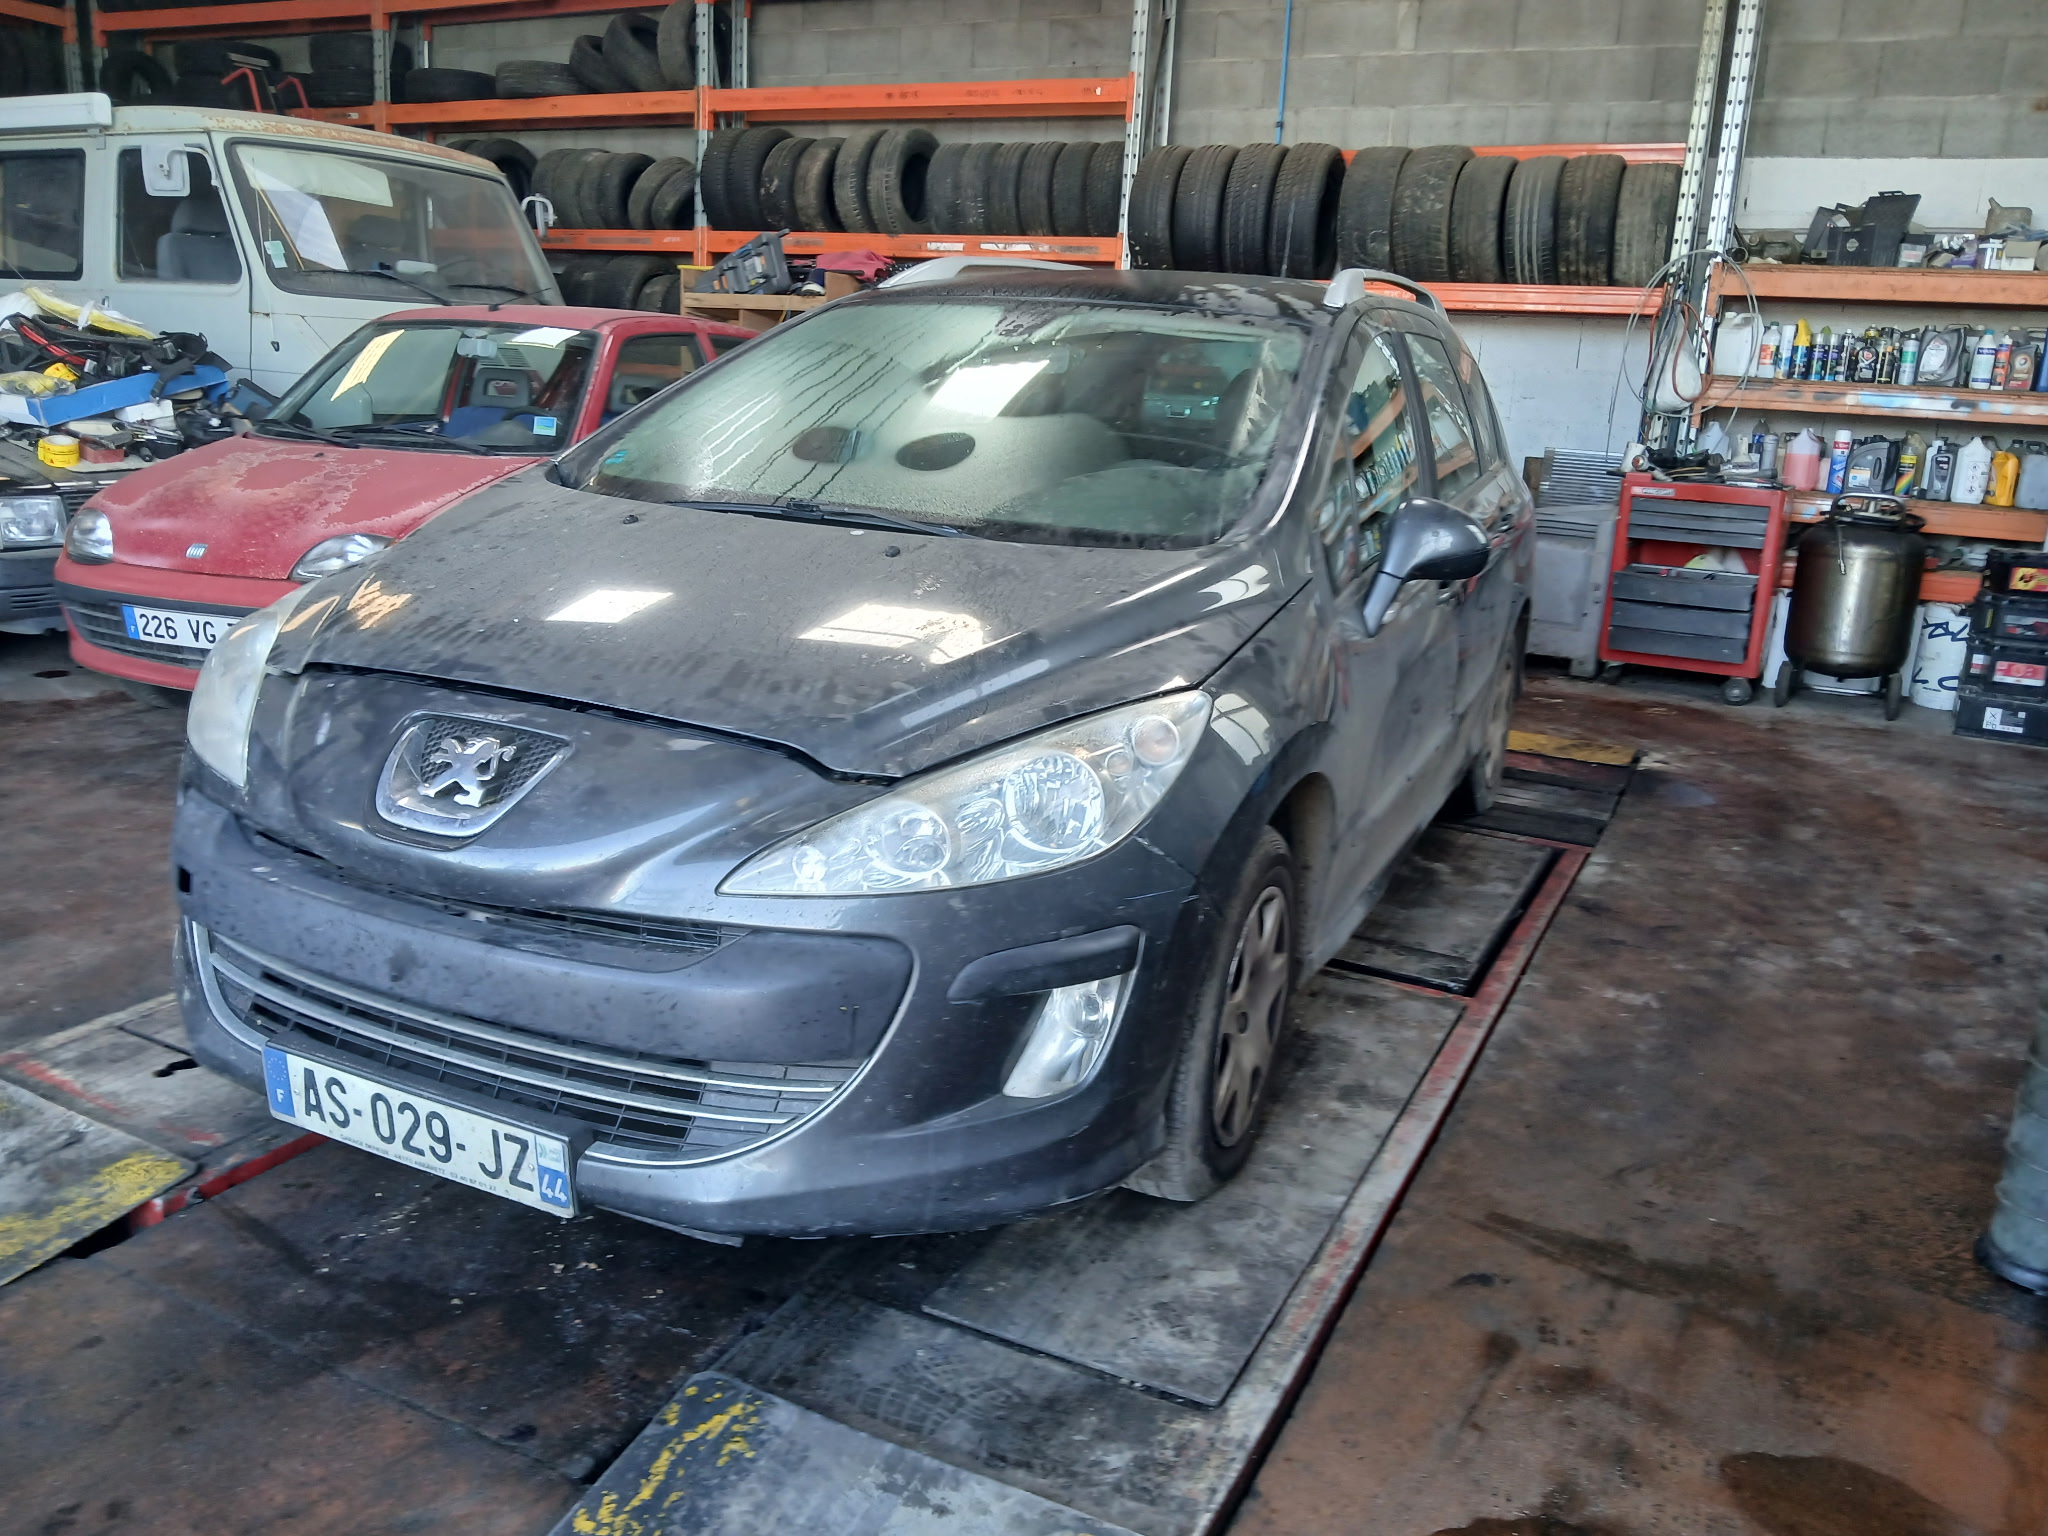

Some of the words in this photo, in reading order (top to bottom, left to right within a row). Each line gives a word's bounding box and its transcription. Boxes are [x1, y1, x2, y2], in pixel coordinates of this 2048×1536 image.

[139, 613, 178, 640] 226
[187, 618, 217, 644] VG
[276, 1088, 285, 1103] F
[541, 1173, 568, 1203] 44
